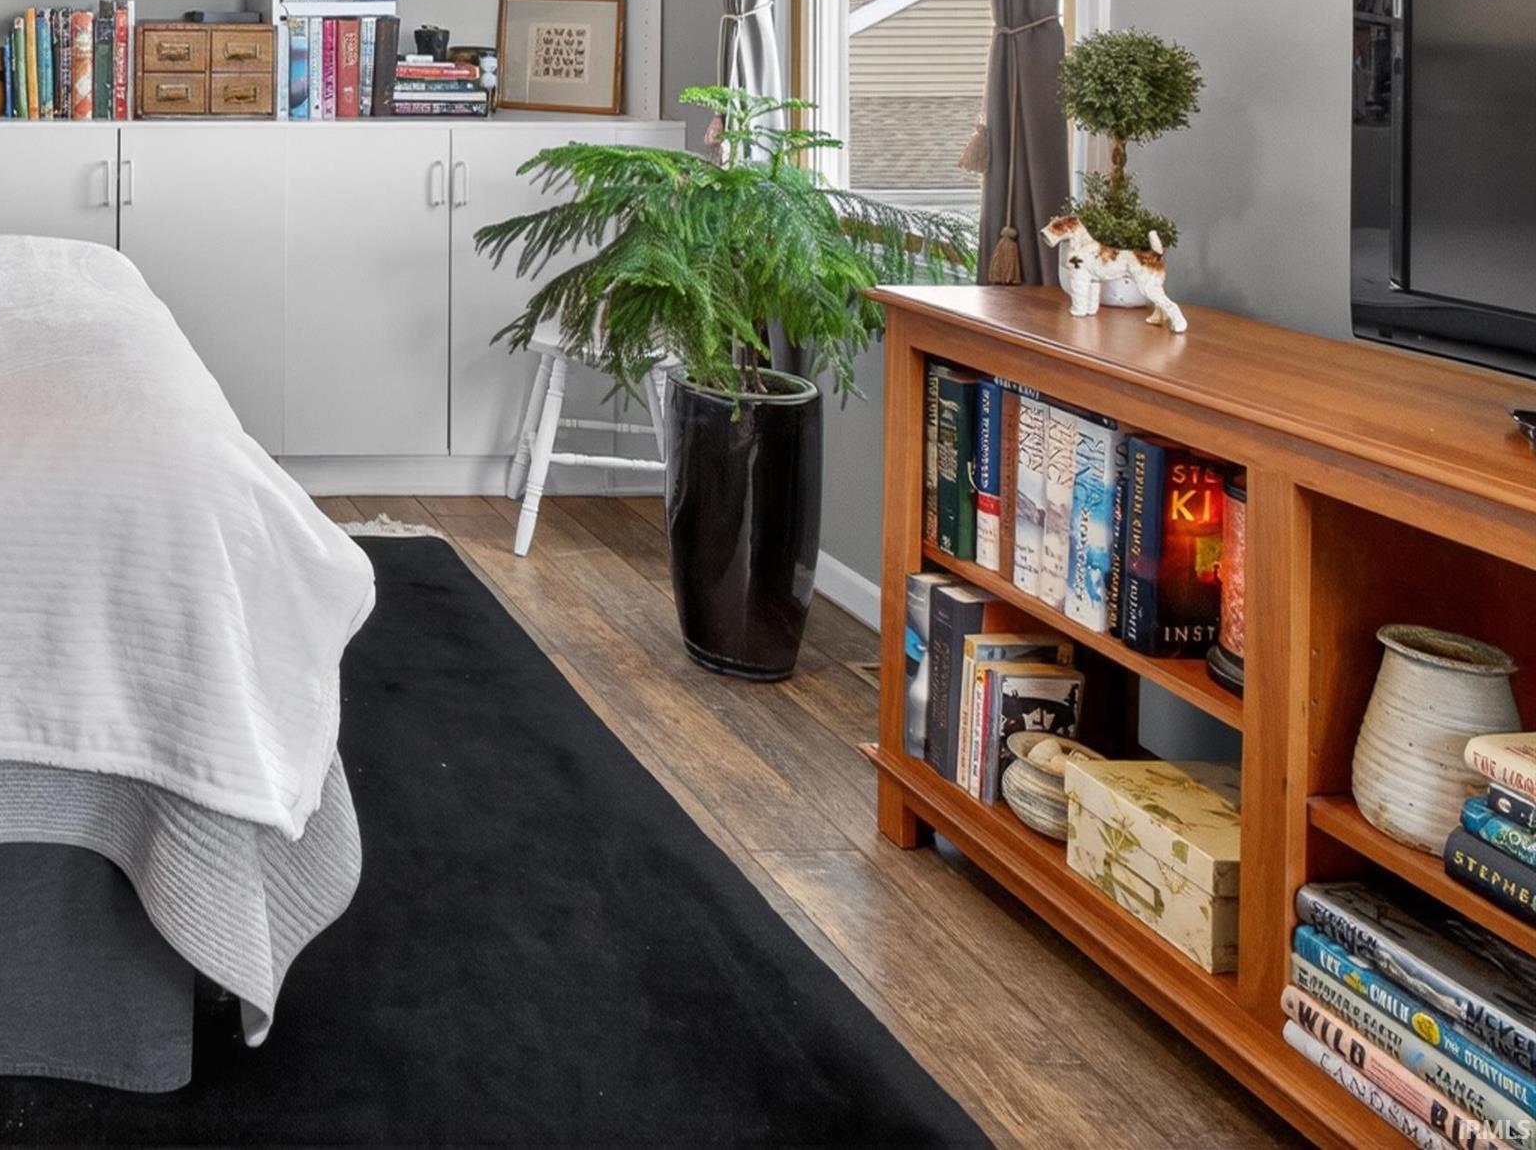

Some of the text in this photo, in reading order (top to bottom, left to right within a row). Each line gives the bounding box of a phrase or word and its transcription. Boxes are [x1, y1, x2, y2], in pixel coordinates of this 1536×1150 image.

[1172, 464, 1217, 484] STE
[1172, 489, 1212, 521] KI
[1164, 625, 1216, 642] INST
[1453, 850, 1531, 904] STEPHE
